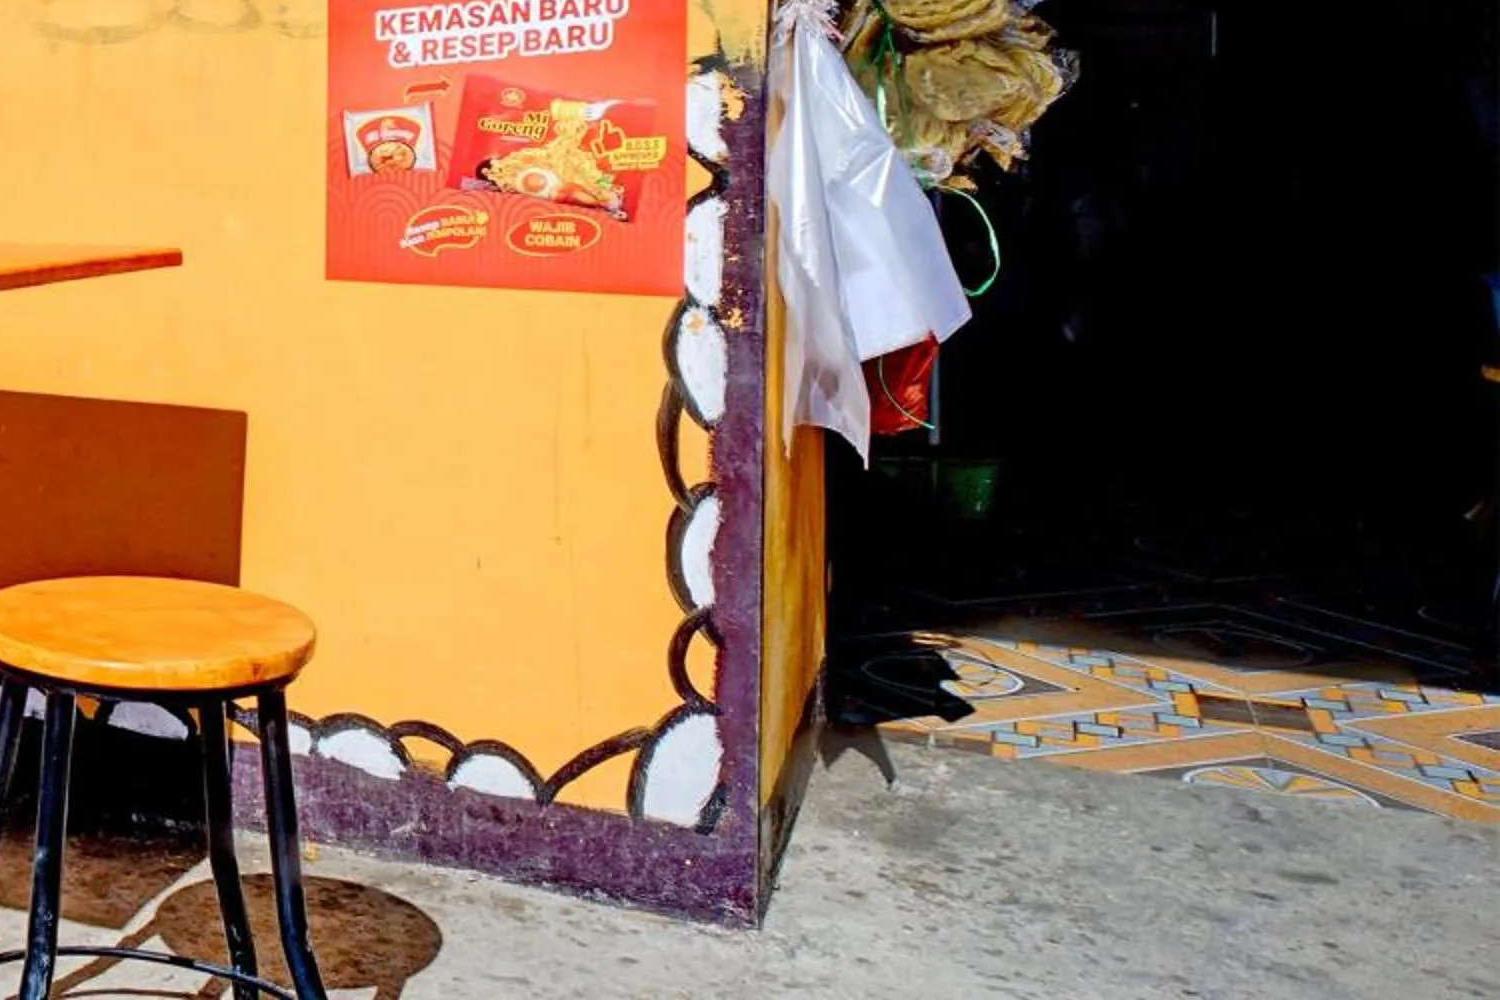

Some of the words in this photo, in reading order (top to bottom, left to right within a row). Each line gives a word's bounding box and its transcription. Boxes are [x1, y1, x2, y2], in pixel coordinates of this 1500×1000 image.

[392, 40, 412, 65] &
[420, 31, 518, 62] RESEP
[523, 21, 610, 53] BARU
[526, 110, 549, 125] Mi
[479, 118, 547, 140] Goreng
[529, 220, 576, 233] WAJIB
[524, 233, 581, 248] COBAIN
